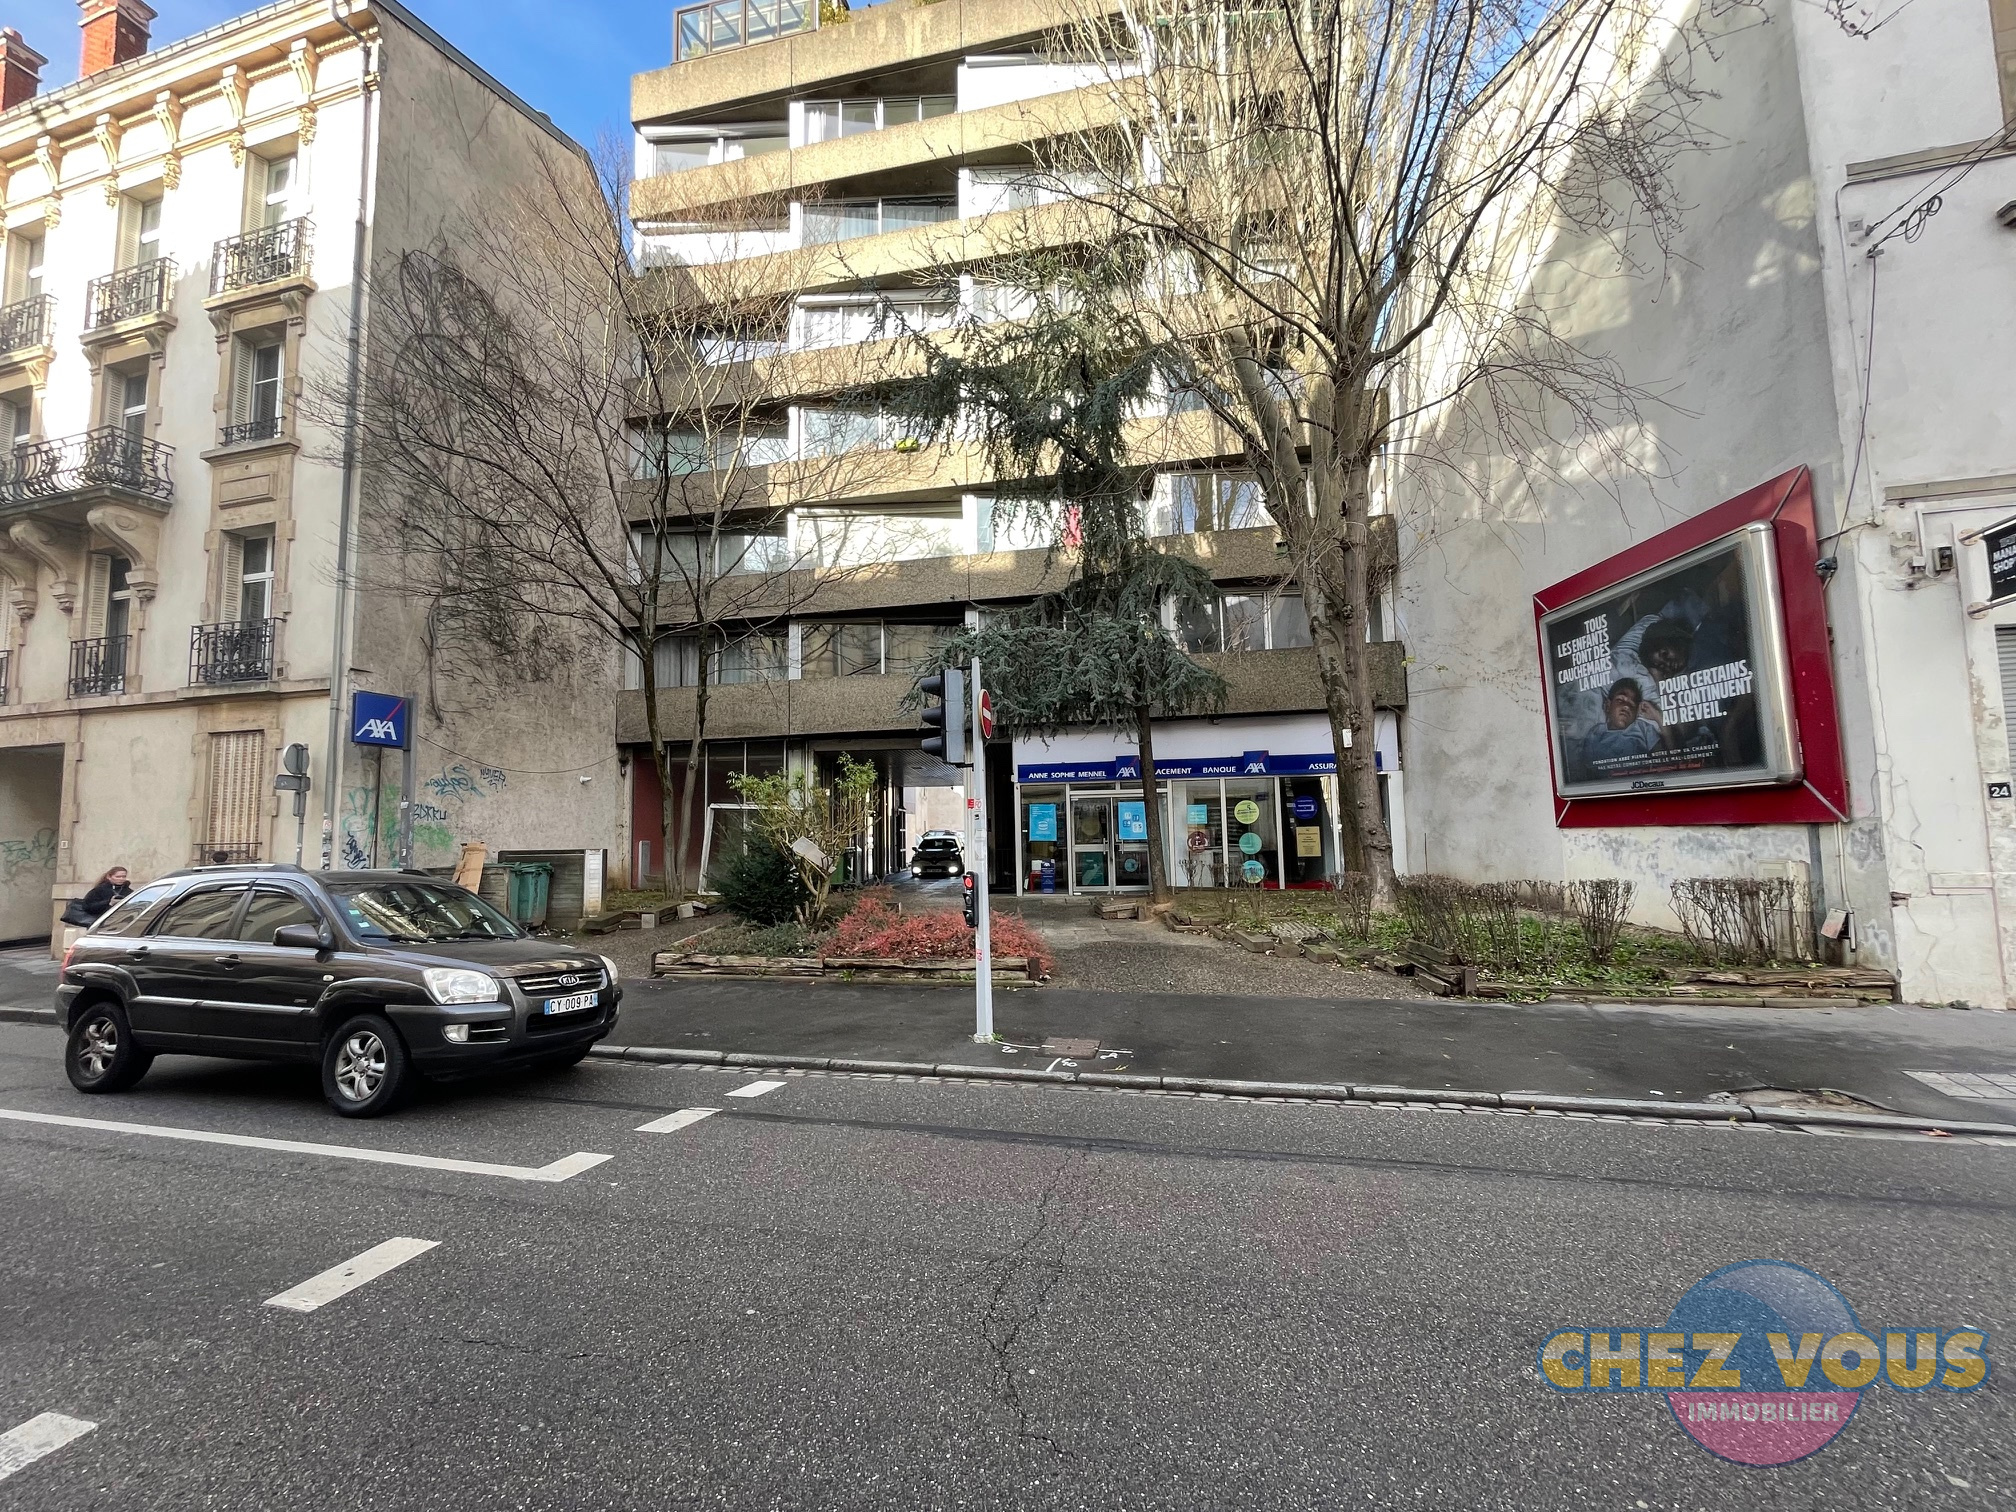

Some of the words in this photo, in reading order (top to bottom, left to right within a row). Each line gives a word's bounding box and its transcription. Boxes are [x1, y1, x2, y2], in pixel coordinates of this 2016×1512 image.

[1584, 613, 1608, 634] TOUS
[1557, 641, 1572, 658] LES
[1571, 627, 1610, 653] ENFANTS
[1572, 647, 1592, 667] FONT
[1593, 641, 1611, 660] DES
[1558, 655, 1612, 684] CAUCHEMARS
[1658, 674, 1690, 696] POUR
[1689, 659, 1753, 688] CERTAINS,
[1579, 677, 1590, 692] LA
[1590, 671, 1614, 689] NUIT.
[1659, 692, 1677, 711] ILS
[1677, 676, 1752, 707] CONTINUENT
[1662, 709, 1679, 727] AU
[355, 718, 397, 741] AXA
[1050, 771, 1075, 779] SOPHIE
[1078, 770, 1107, 778] MENNEL
[1116, 766, 1137, 777] AXA
[1155, 767, 1192, 775] ACEMENT
[1202, 765, 1237, 774] BANQUE
[1244, 762, 1266, 774] AXA
[1630, 781, 1665, 790] JCDecaux
[1990, 786, 2010, 797] 24
[562, 976, 576, 984] KIA
